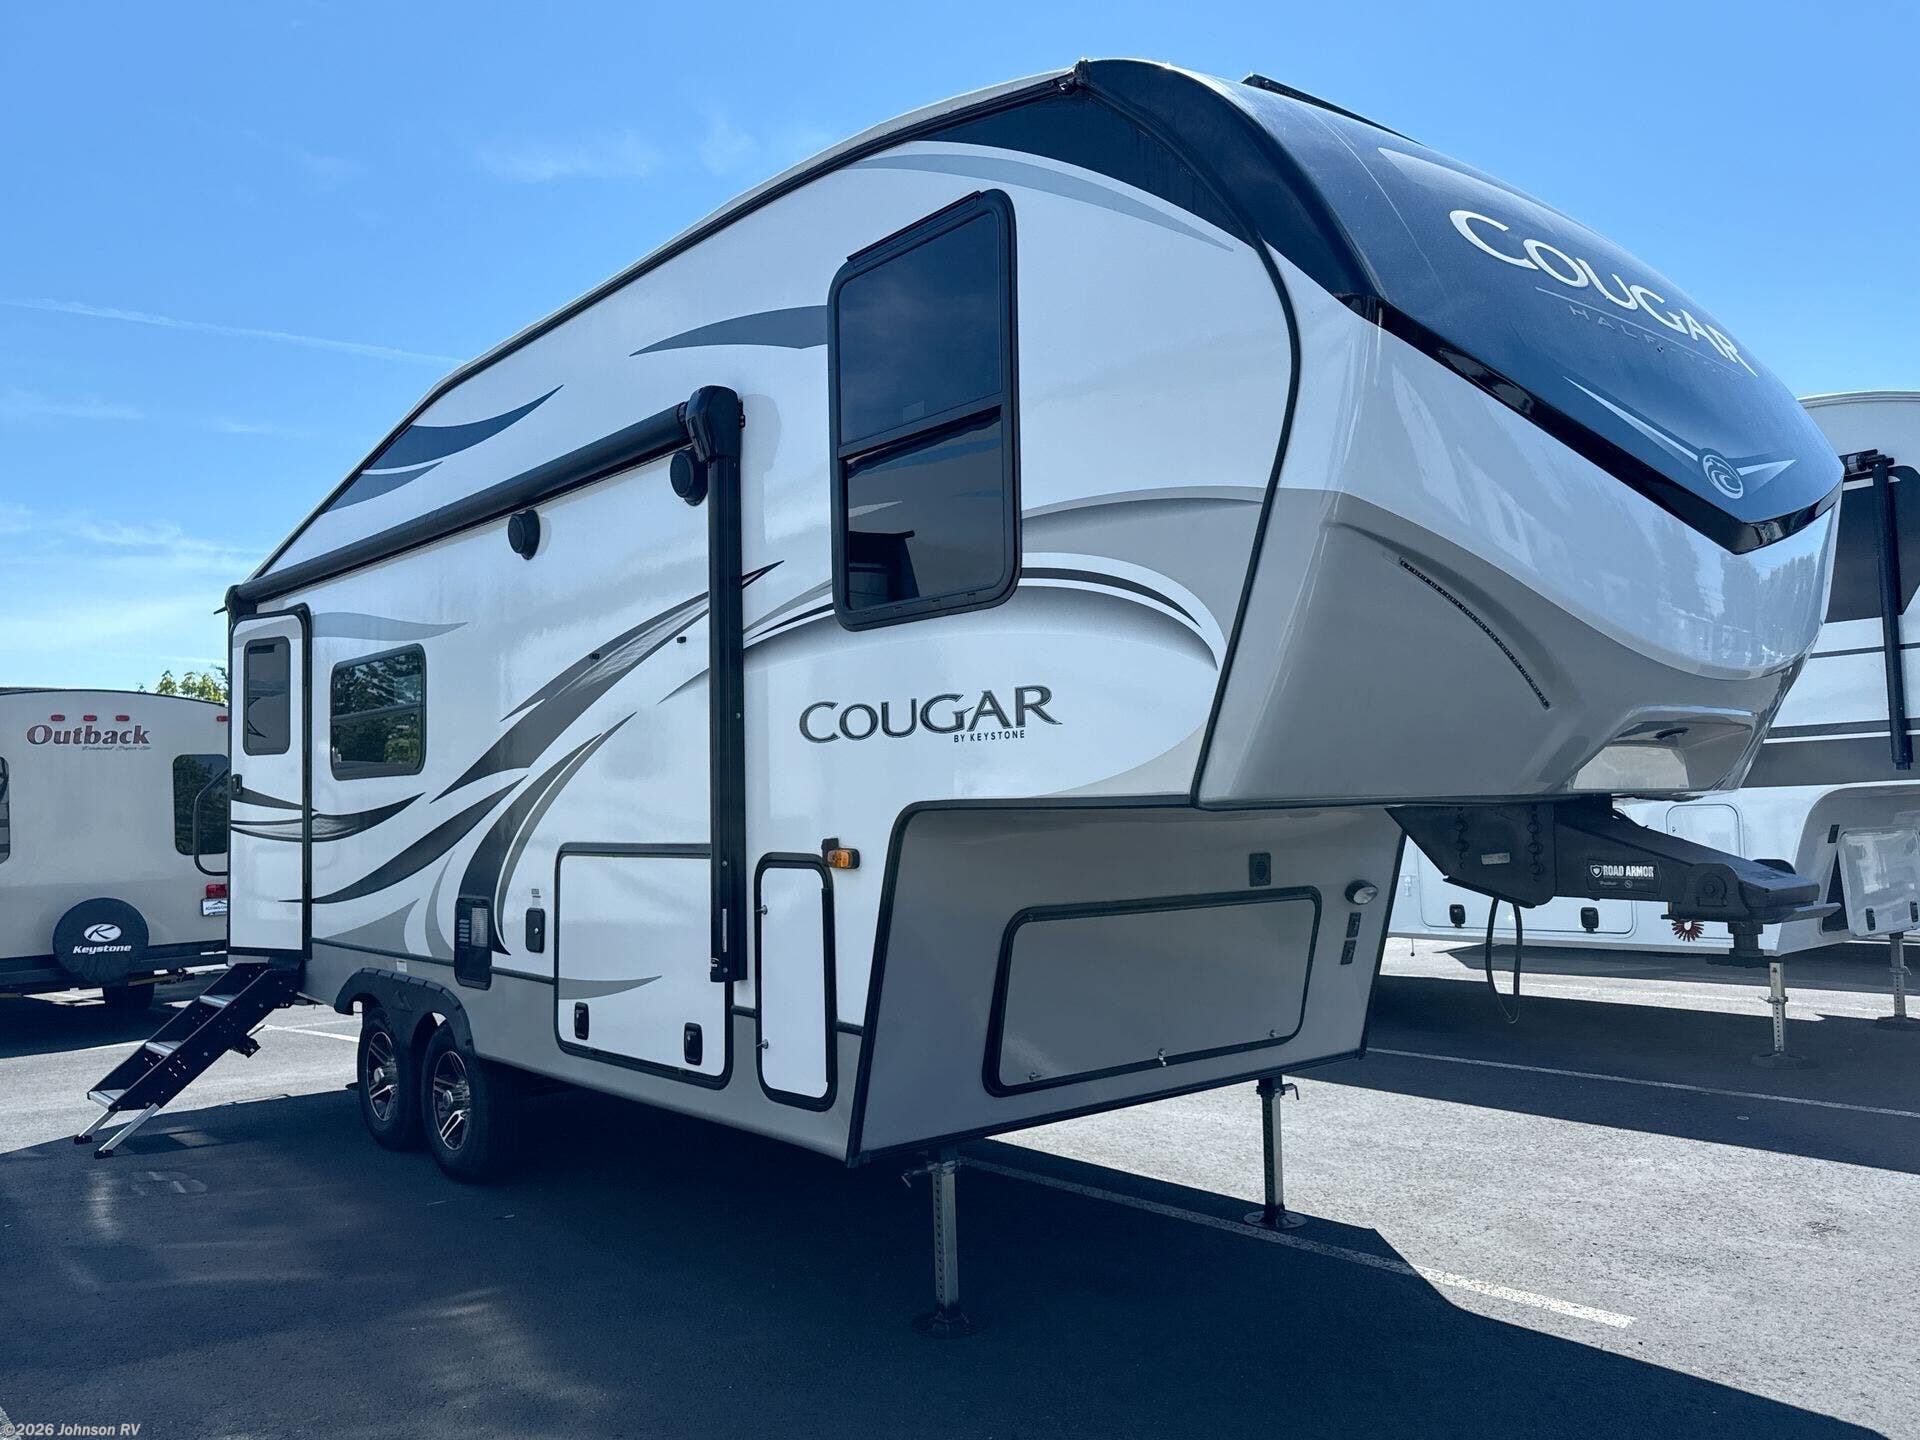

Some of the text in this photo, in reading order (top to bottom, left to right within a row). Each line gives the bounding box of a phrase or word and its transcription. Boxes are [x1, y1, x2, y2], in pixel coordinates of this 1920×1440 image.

[1449, 209, 1759, 378] COUGAR
[798, 684, 1064, 744] COUGAR
[26, 724, 151, 746] Outback
[953, 729, 1026, 743] BY KEYSTONE
[1602, 864, 1655, 878] ROAD ARMOR
[72, 944, 133, 955] Keystone
